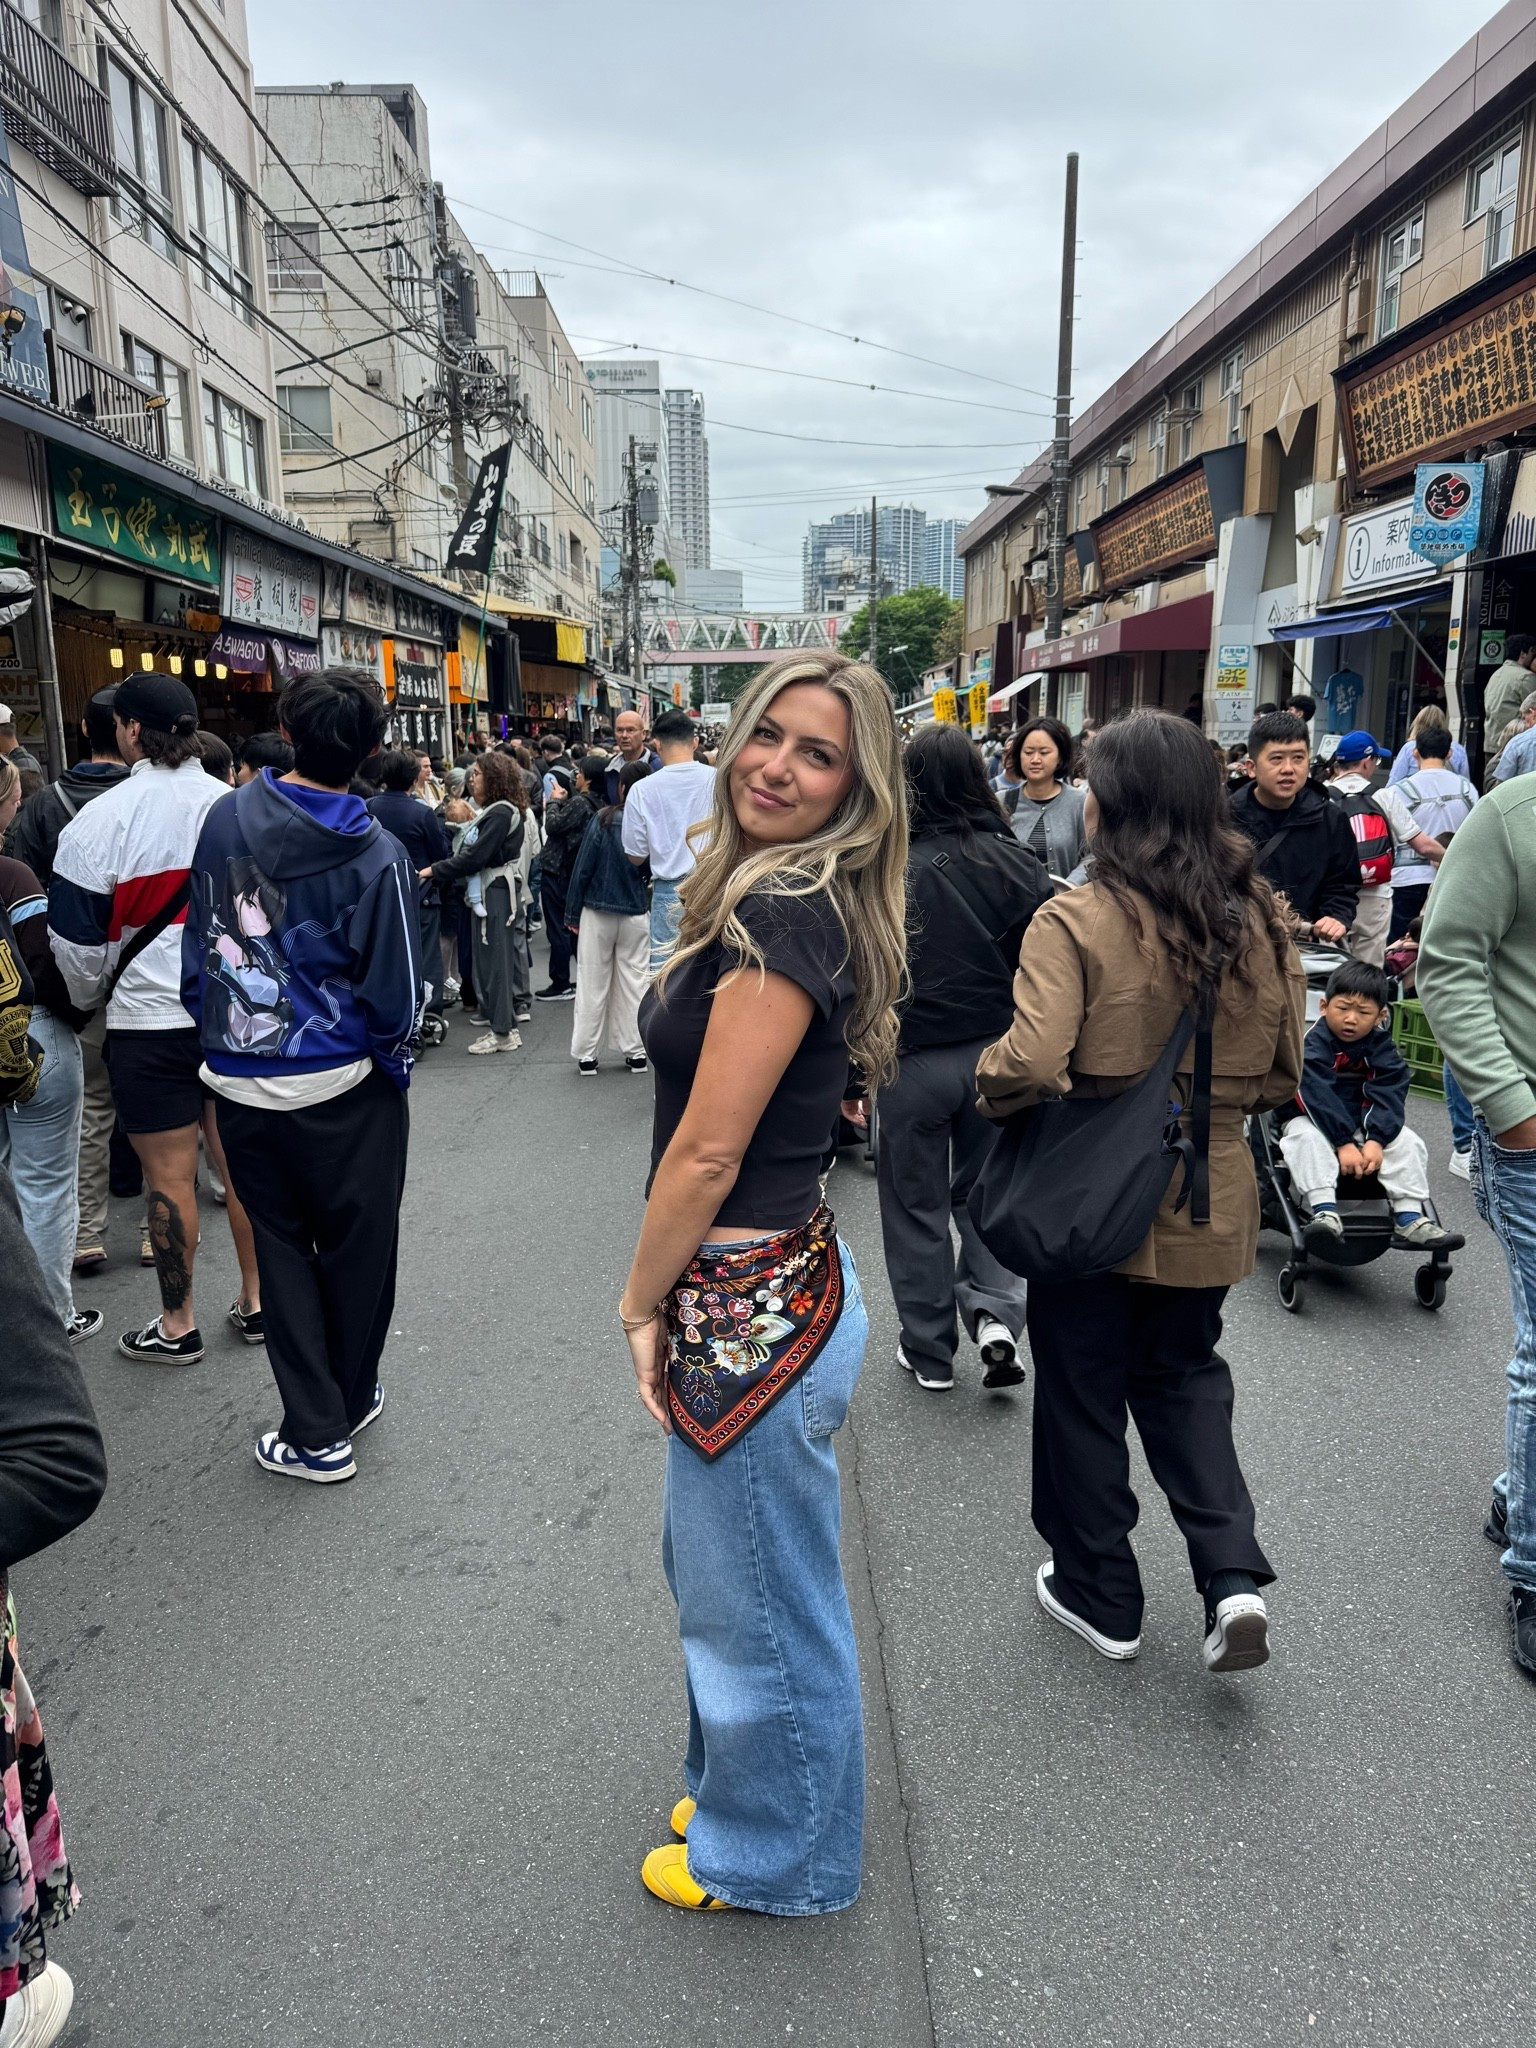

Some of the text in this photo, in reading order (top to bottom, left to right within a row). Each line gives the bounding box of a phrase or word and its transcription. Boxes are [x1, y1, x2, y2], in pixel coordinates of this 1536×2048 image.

[1473, 347, 1491, 419] 藤本商店
[1511, 326, 1530, 403] 服部商店
[1386, 515, 1411, 546] 案内
[1372, 551, 1425, 575] Informatio
[1479, 580, 1491, 625] NIPPON
[1224, 668, 1246, 676] コイン
